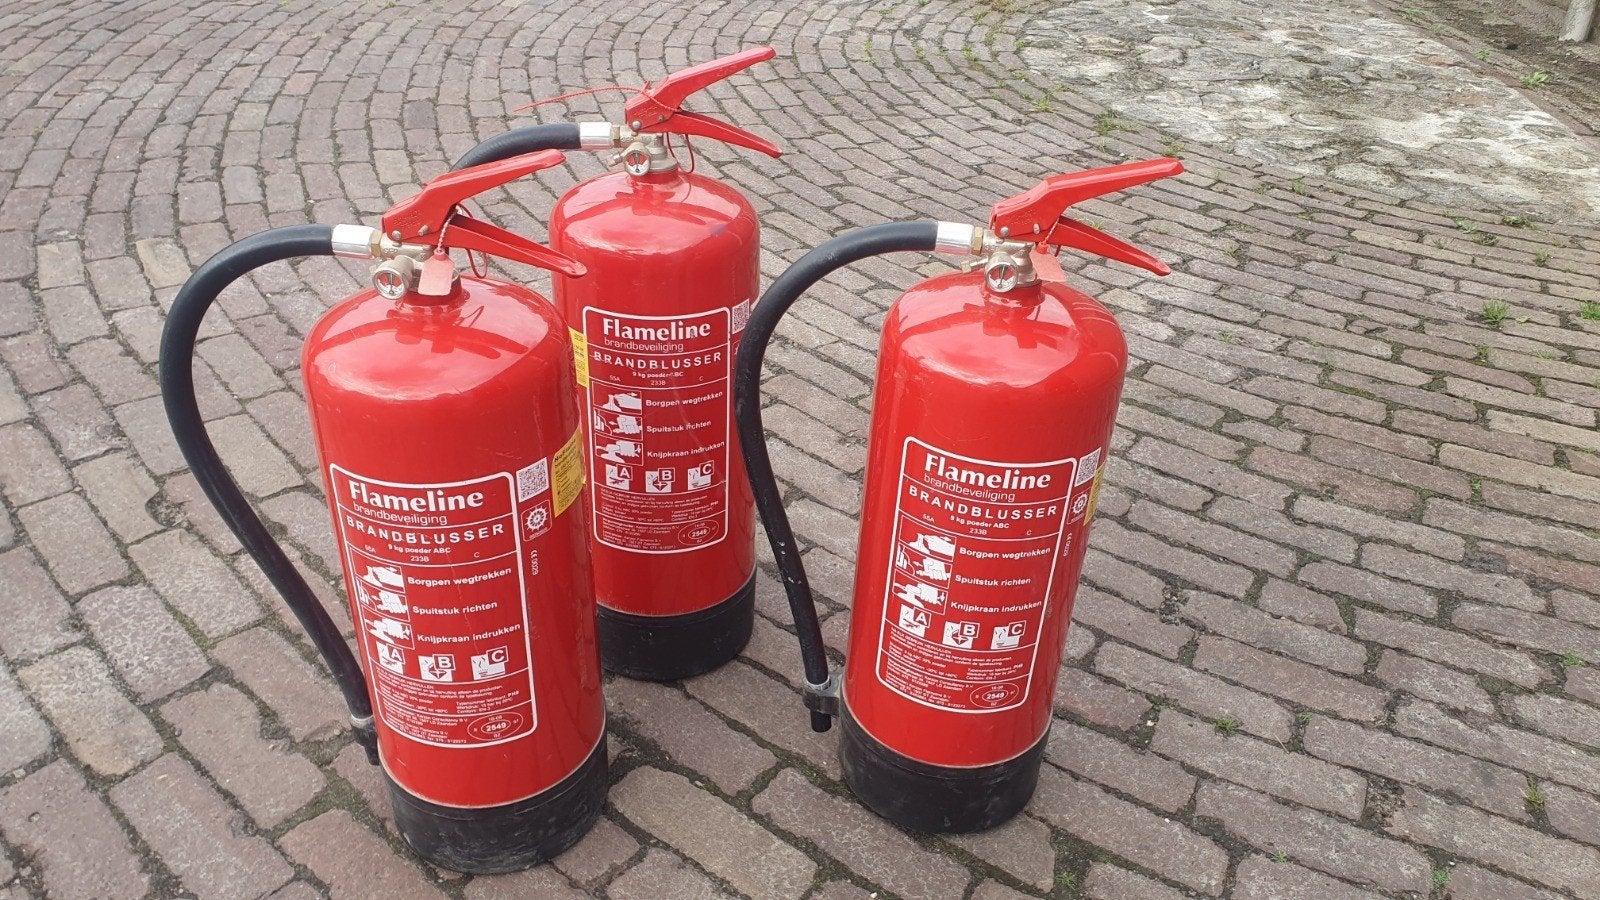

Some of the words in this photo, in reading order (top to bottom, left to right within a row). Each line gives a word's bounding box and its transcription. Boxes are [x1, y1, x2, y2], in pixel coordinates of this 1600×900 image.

[603, 317, 711, 341] Flameline
[604, 337, 684, 353] brandbeveiliging
[593, 351, 722, 370] BRANDBLUSSER
[645, 399, 681, 408] Borgpen
[682, 391, 723, 406] wegtrekken
[646, 425, 684, 434] Spuitstuk
[647, 450, 689, 459] Knijpkraan
[691, 440, 725, 456] indrukken
[619, 468, 631, 479] A
[661, 470, 673, 480] B
[702, 464, 712, 475] C
[924, 453, 1051, 490] Flameline
[348, 479, 484, 512] Flameline
[924, 473, 1015, 502] brandbeveiliging
[909, 484, 1057, 520] BRANDBLUSSER
[353, 501, 447, 526] brandbeveiliging
[956, 517, 965, 525] kg
[966, 520, 992, 528] poeder
[993, 521, 1010, 529] ABC
[346, 515, 504, 545] BRANDBLUSSER
[394, 545, 404, 554] kg
[959, 546, 1000, 559] Borgpen
[1001, 547, 1051, 560] wegtrekken
[407, 576, 450, 588] Borgpen
[453, 567, 512, 585] wegtrekken
[955, 574, 998, 586] Spuitstuk
[1001, 577, 1031, 586] richten
[412, 605, 460, 616] Spuitstuk
[462, 601, 498, 614] richten
[950, 601, 999, 613] Knijpkraan
[1001, 600, 1042, 613] indrukken
[915, 612, 928, 625] A
[962, 623, 976, 635] B
[1011, 622, 1023, 635] C
[417, 634, 470, 645] Knijpkraan
[473, 623, 521, 641] indrukken
[390, 649, 402, 663] A
[438, 656, 452, 669] B
[491, 649, 505, 663] C
